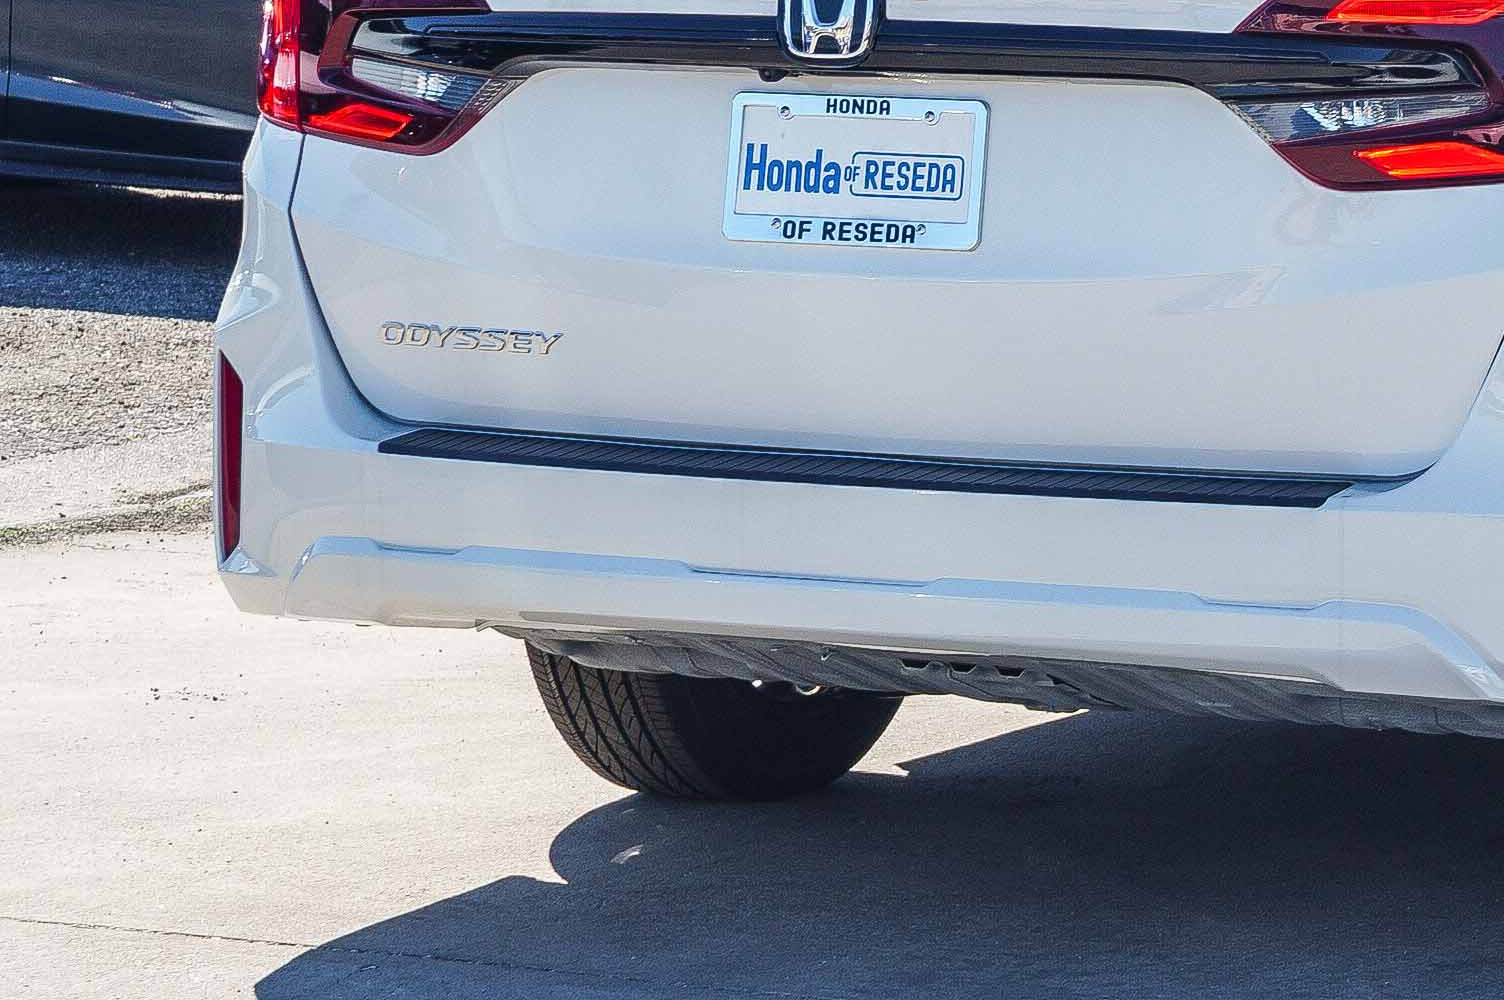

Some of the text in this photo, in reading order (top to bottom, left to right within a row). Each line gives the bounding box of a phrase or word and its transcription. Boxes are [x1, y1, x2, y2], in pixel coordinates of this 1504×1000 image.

[826, 98, 891, 116] HONDA
[743, 143, 956, 194] Honda OF RESEDA
[782, 220, 916, 243] OF RESEDA
[381, 320, 565, 355] ODYSSEY
